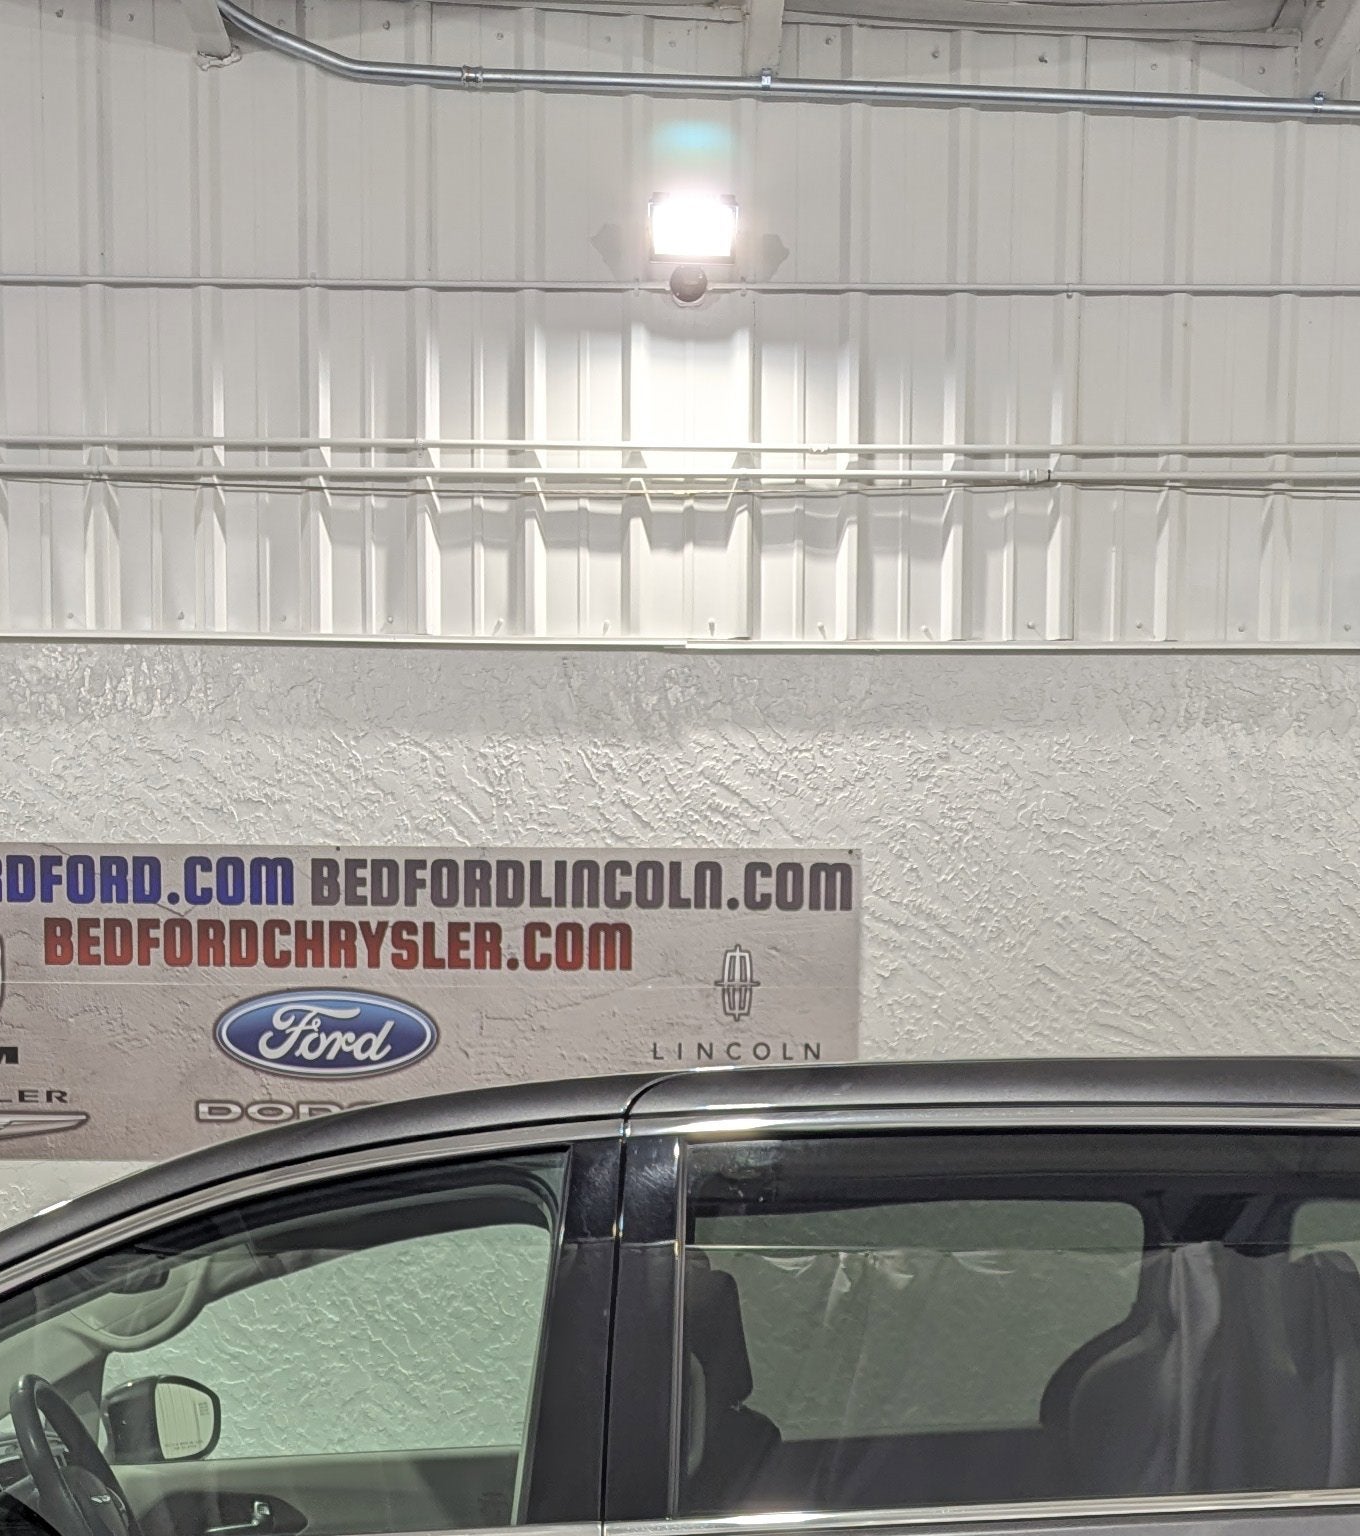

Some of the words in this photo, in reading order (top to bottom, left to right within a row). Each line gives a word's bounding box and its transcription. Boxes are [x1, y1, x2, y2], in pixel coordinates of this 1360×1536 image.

[310, 858, 854, 912] BEDFORDLINCOLN.COM
[43, 916, 633, 972] BEDFORDCHRYSLER.COM
[258, 1003, 396, 1062] Ford
[652, 1042, 822, 1062] LINCOLN
